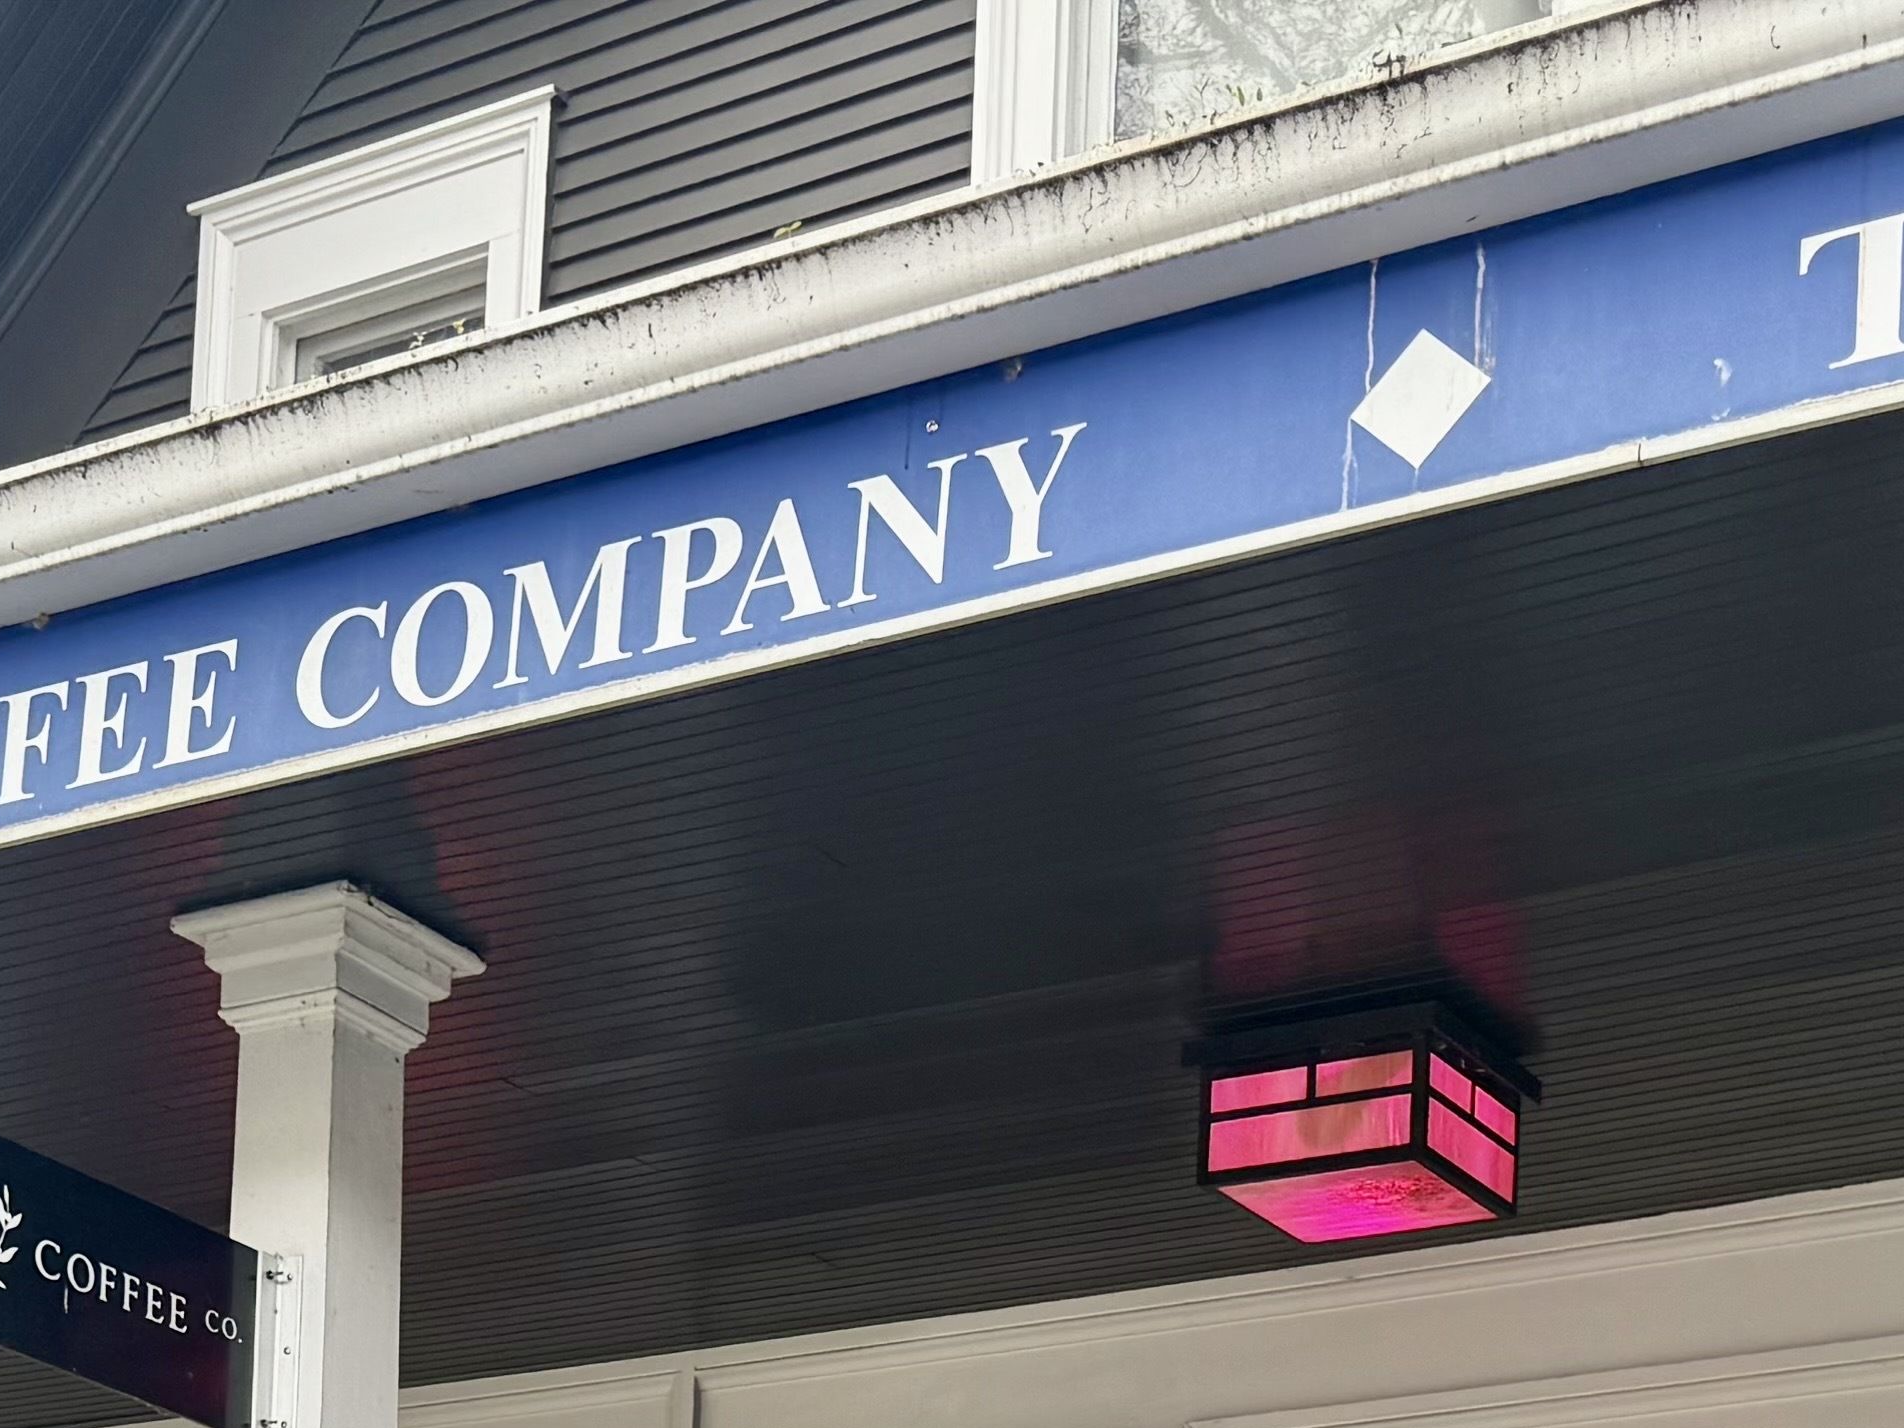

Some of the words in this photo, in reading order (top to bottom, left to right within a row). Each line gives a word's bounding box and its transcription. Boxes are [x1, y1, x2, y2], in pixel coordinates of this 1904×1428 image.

[296, 423, 1087, 729] COMPANY
[35, 1239, 187, 1334] COFFEE
[205, 1309, 243, 1344] CO.
